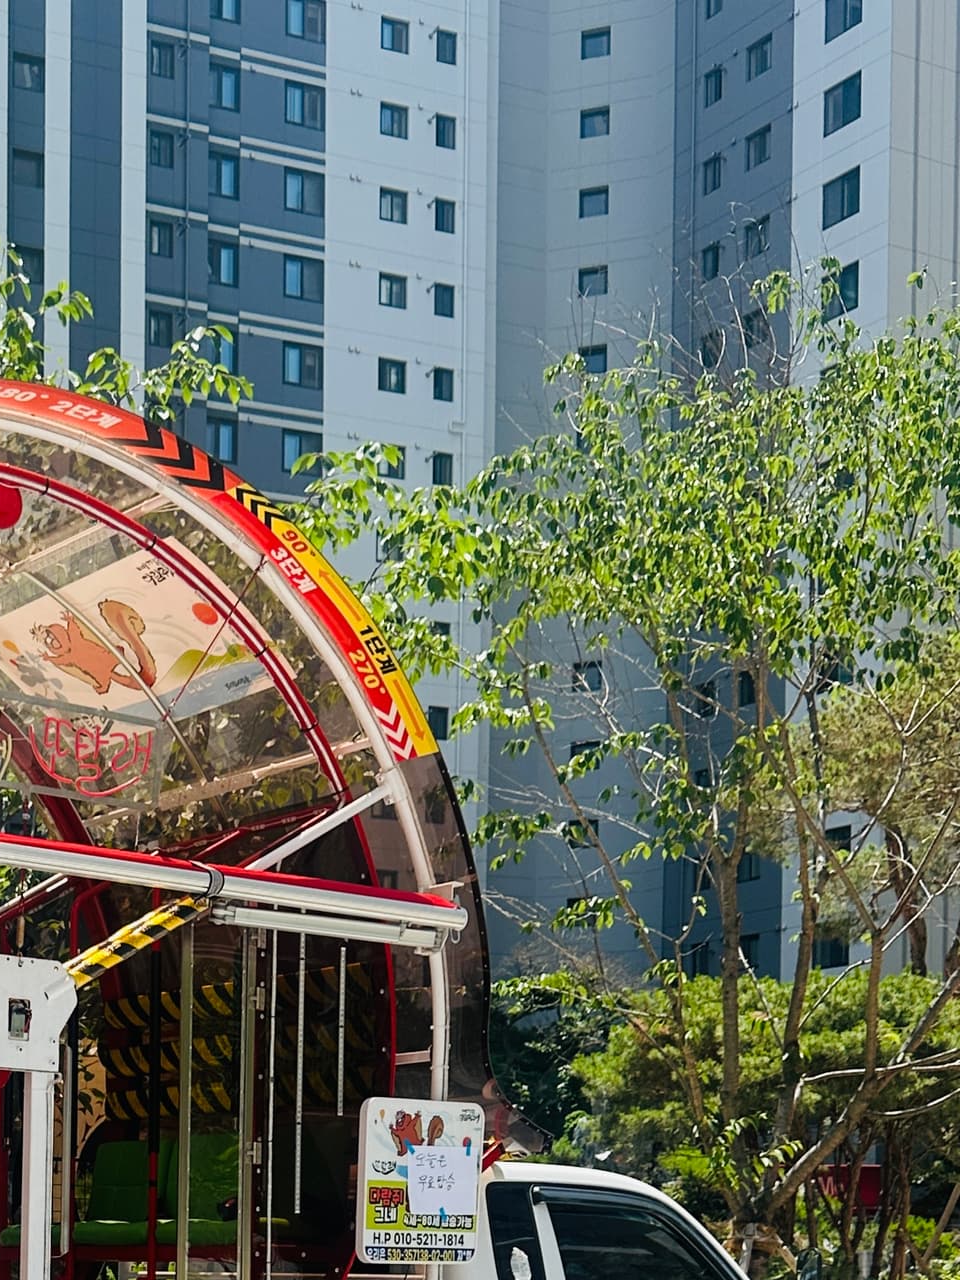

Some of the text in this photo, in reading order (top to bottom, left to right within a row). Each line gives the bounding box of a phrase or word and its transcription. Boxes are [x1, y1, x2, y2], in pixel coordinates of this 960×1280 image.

[48, 400, 123, 429] 2단계
[270, 547, 318, 594] 3단계
[360, 625, 398, 675] 1단계
[369, 1187, 404, 1206] 다람쥐
[374, 1206, 398, 1223] 그네
[373, 1232, 464, 1246] H.P 010-5211-1814
